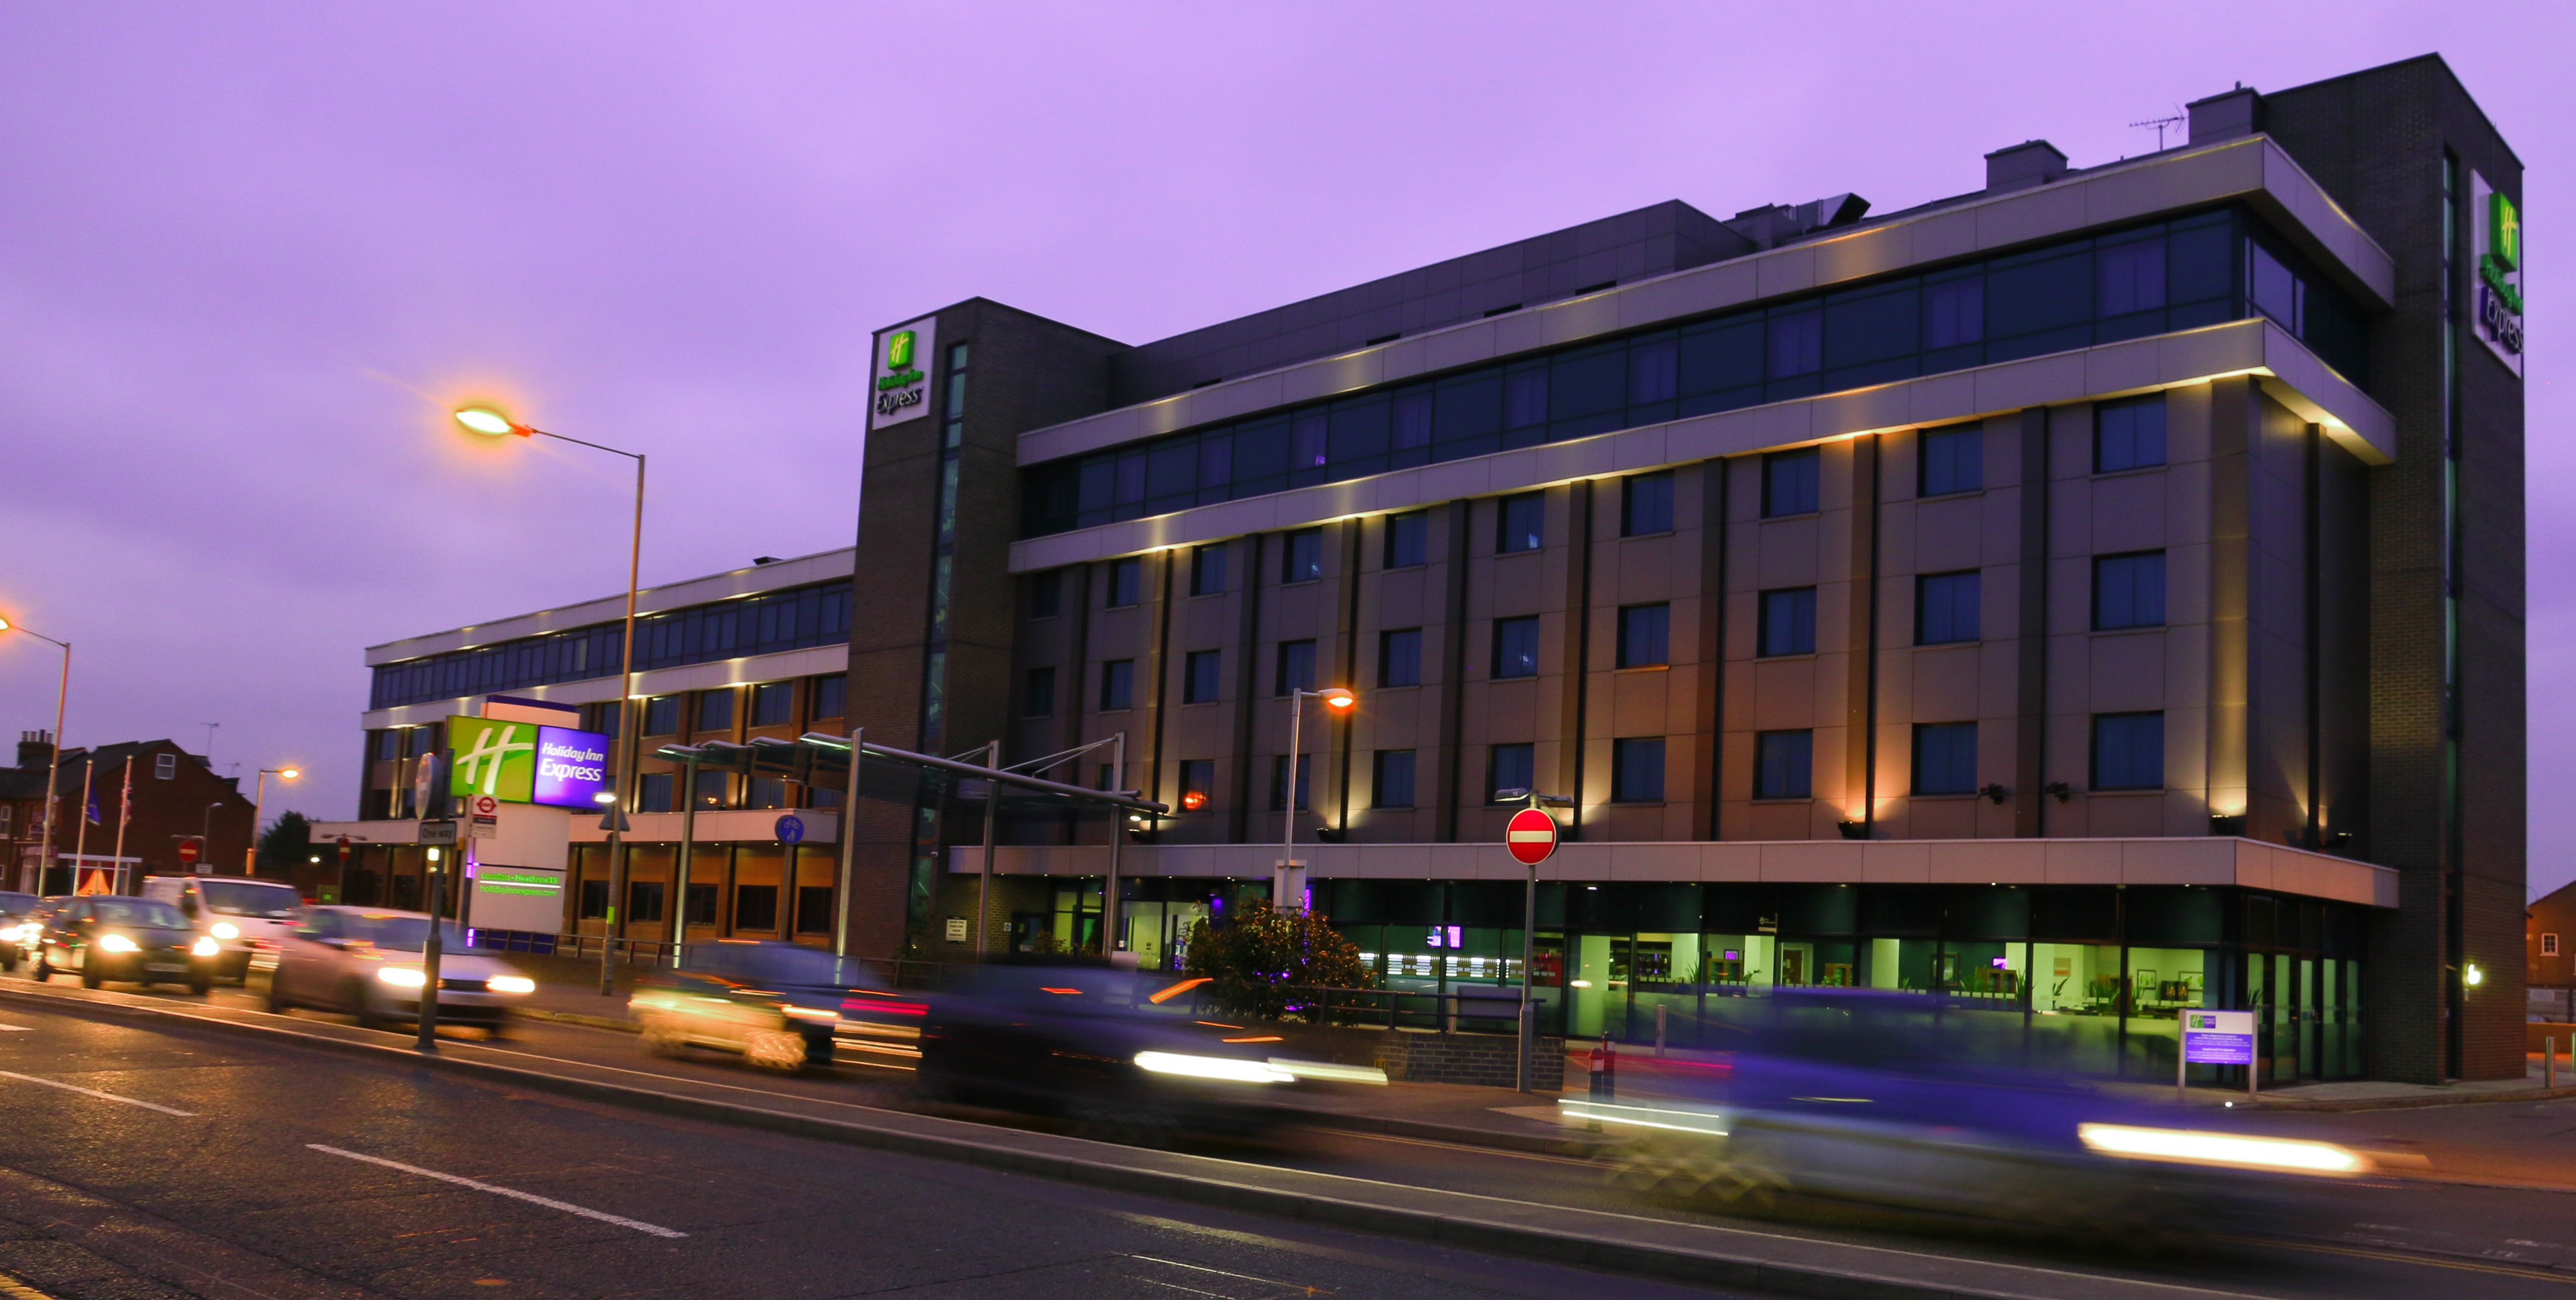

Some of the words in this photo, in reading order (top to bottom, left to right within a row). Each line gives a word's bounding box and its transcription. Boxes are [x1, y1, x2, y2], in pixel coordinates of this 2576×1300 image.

[2481, 286, 2523, 354] Express
[876, 388, 921, 415] Express
[542, 742, 586, 763] Holiday
[585, 748, 604, 762] Inn
[540, 758, 602, 782] Express
[422, 828, 436, 838] One
[438, 830, 453, 839] way
[515, 874, 549, 884] Heathrow
